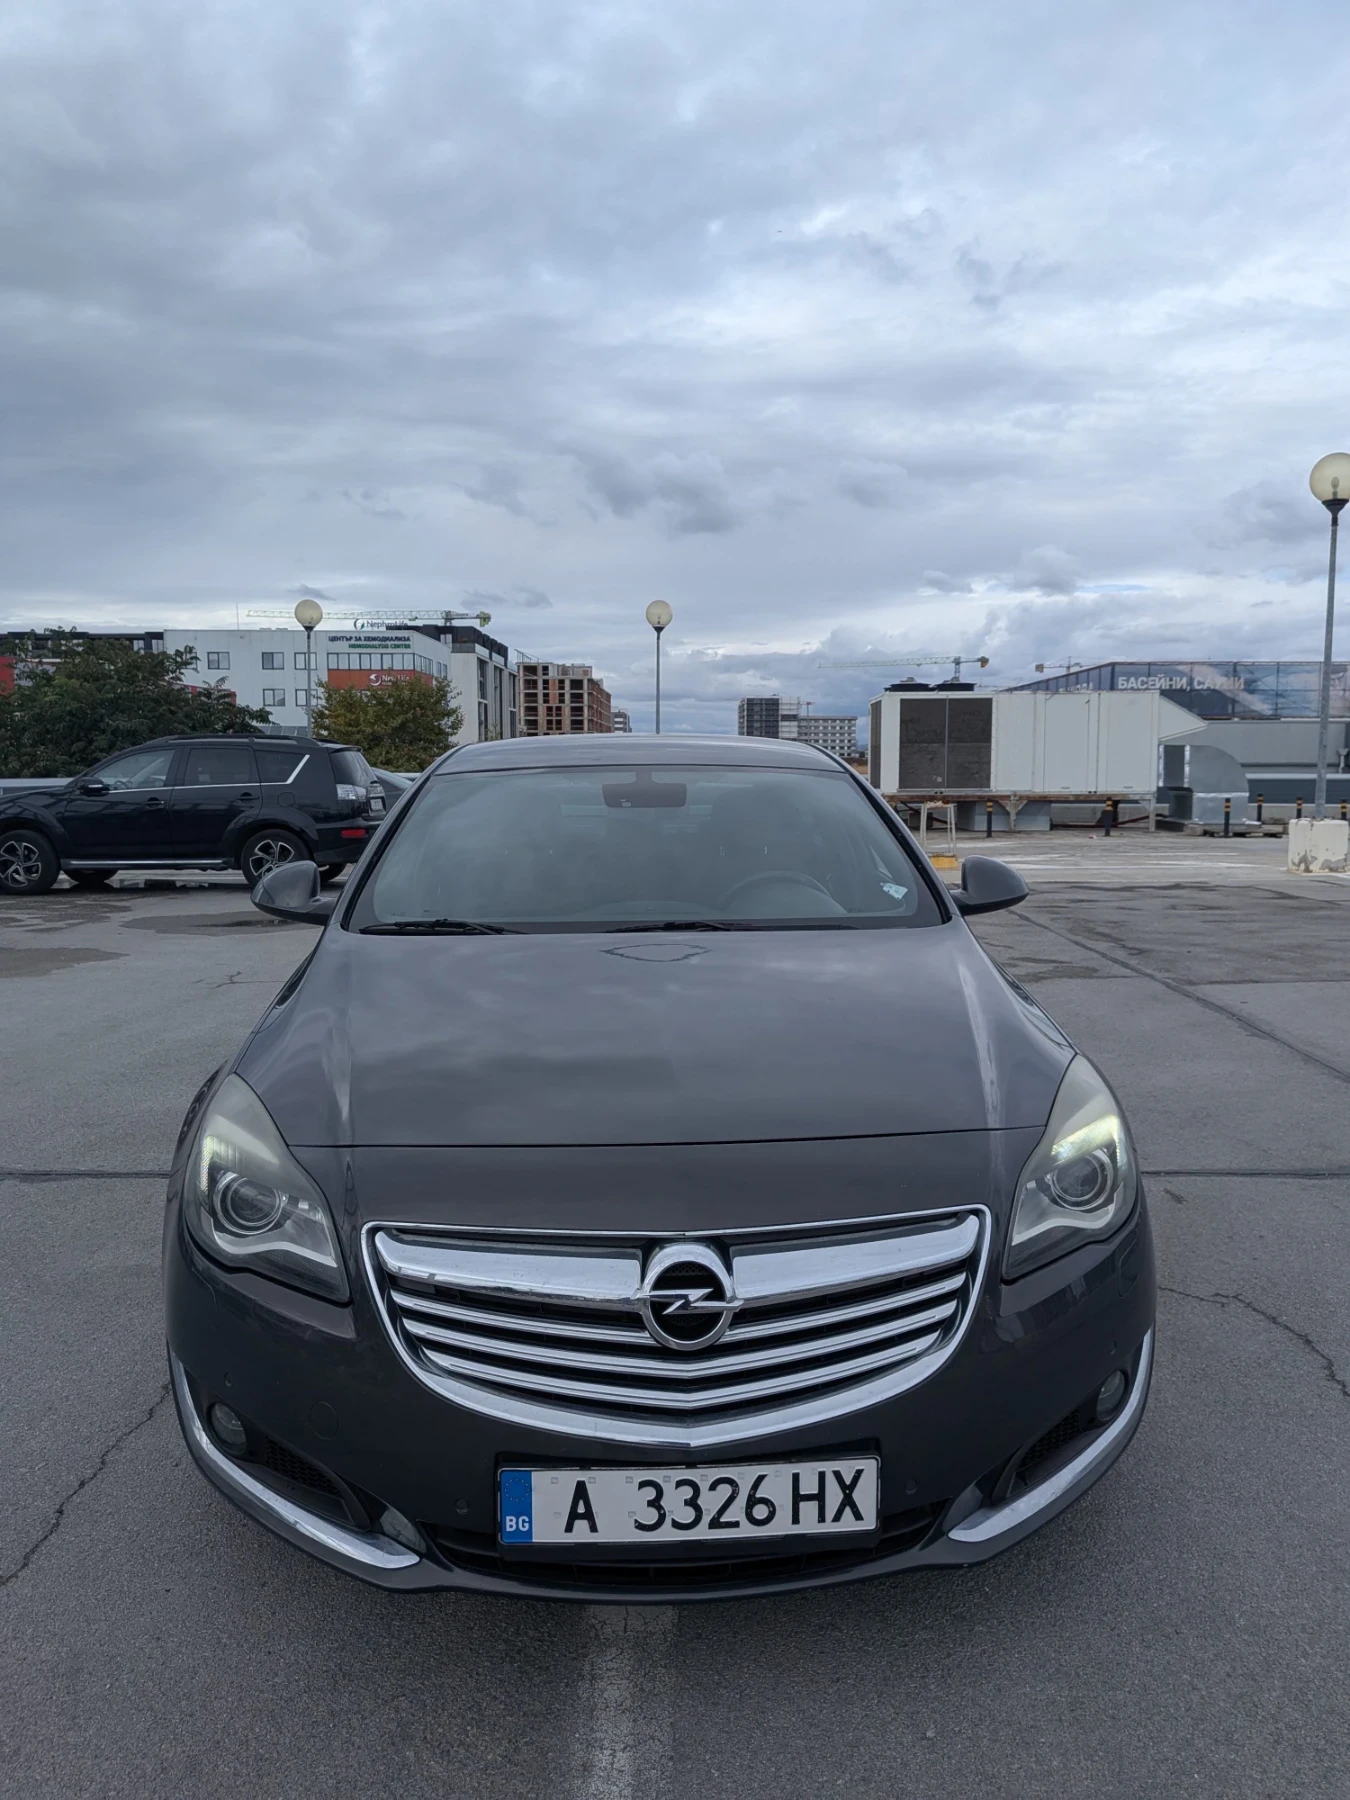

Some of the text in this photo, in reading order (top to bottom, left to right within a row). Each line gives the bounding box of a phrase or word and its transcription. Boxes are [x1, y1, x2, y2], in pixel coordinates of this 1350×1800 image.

[1118, 674, 1245, 692] БАСЕЙНИ, САУНИ
[564, 1479, 599, 1534] A
[505, 1515, 530, 1532] BG
